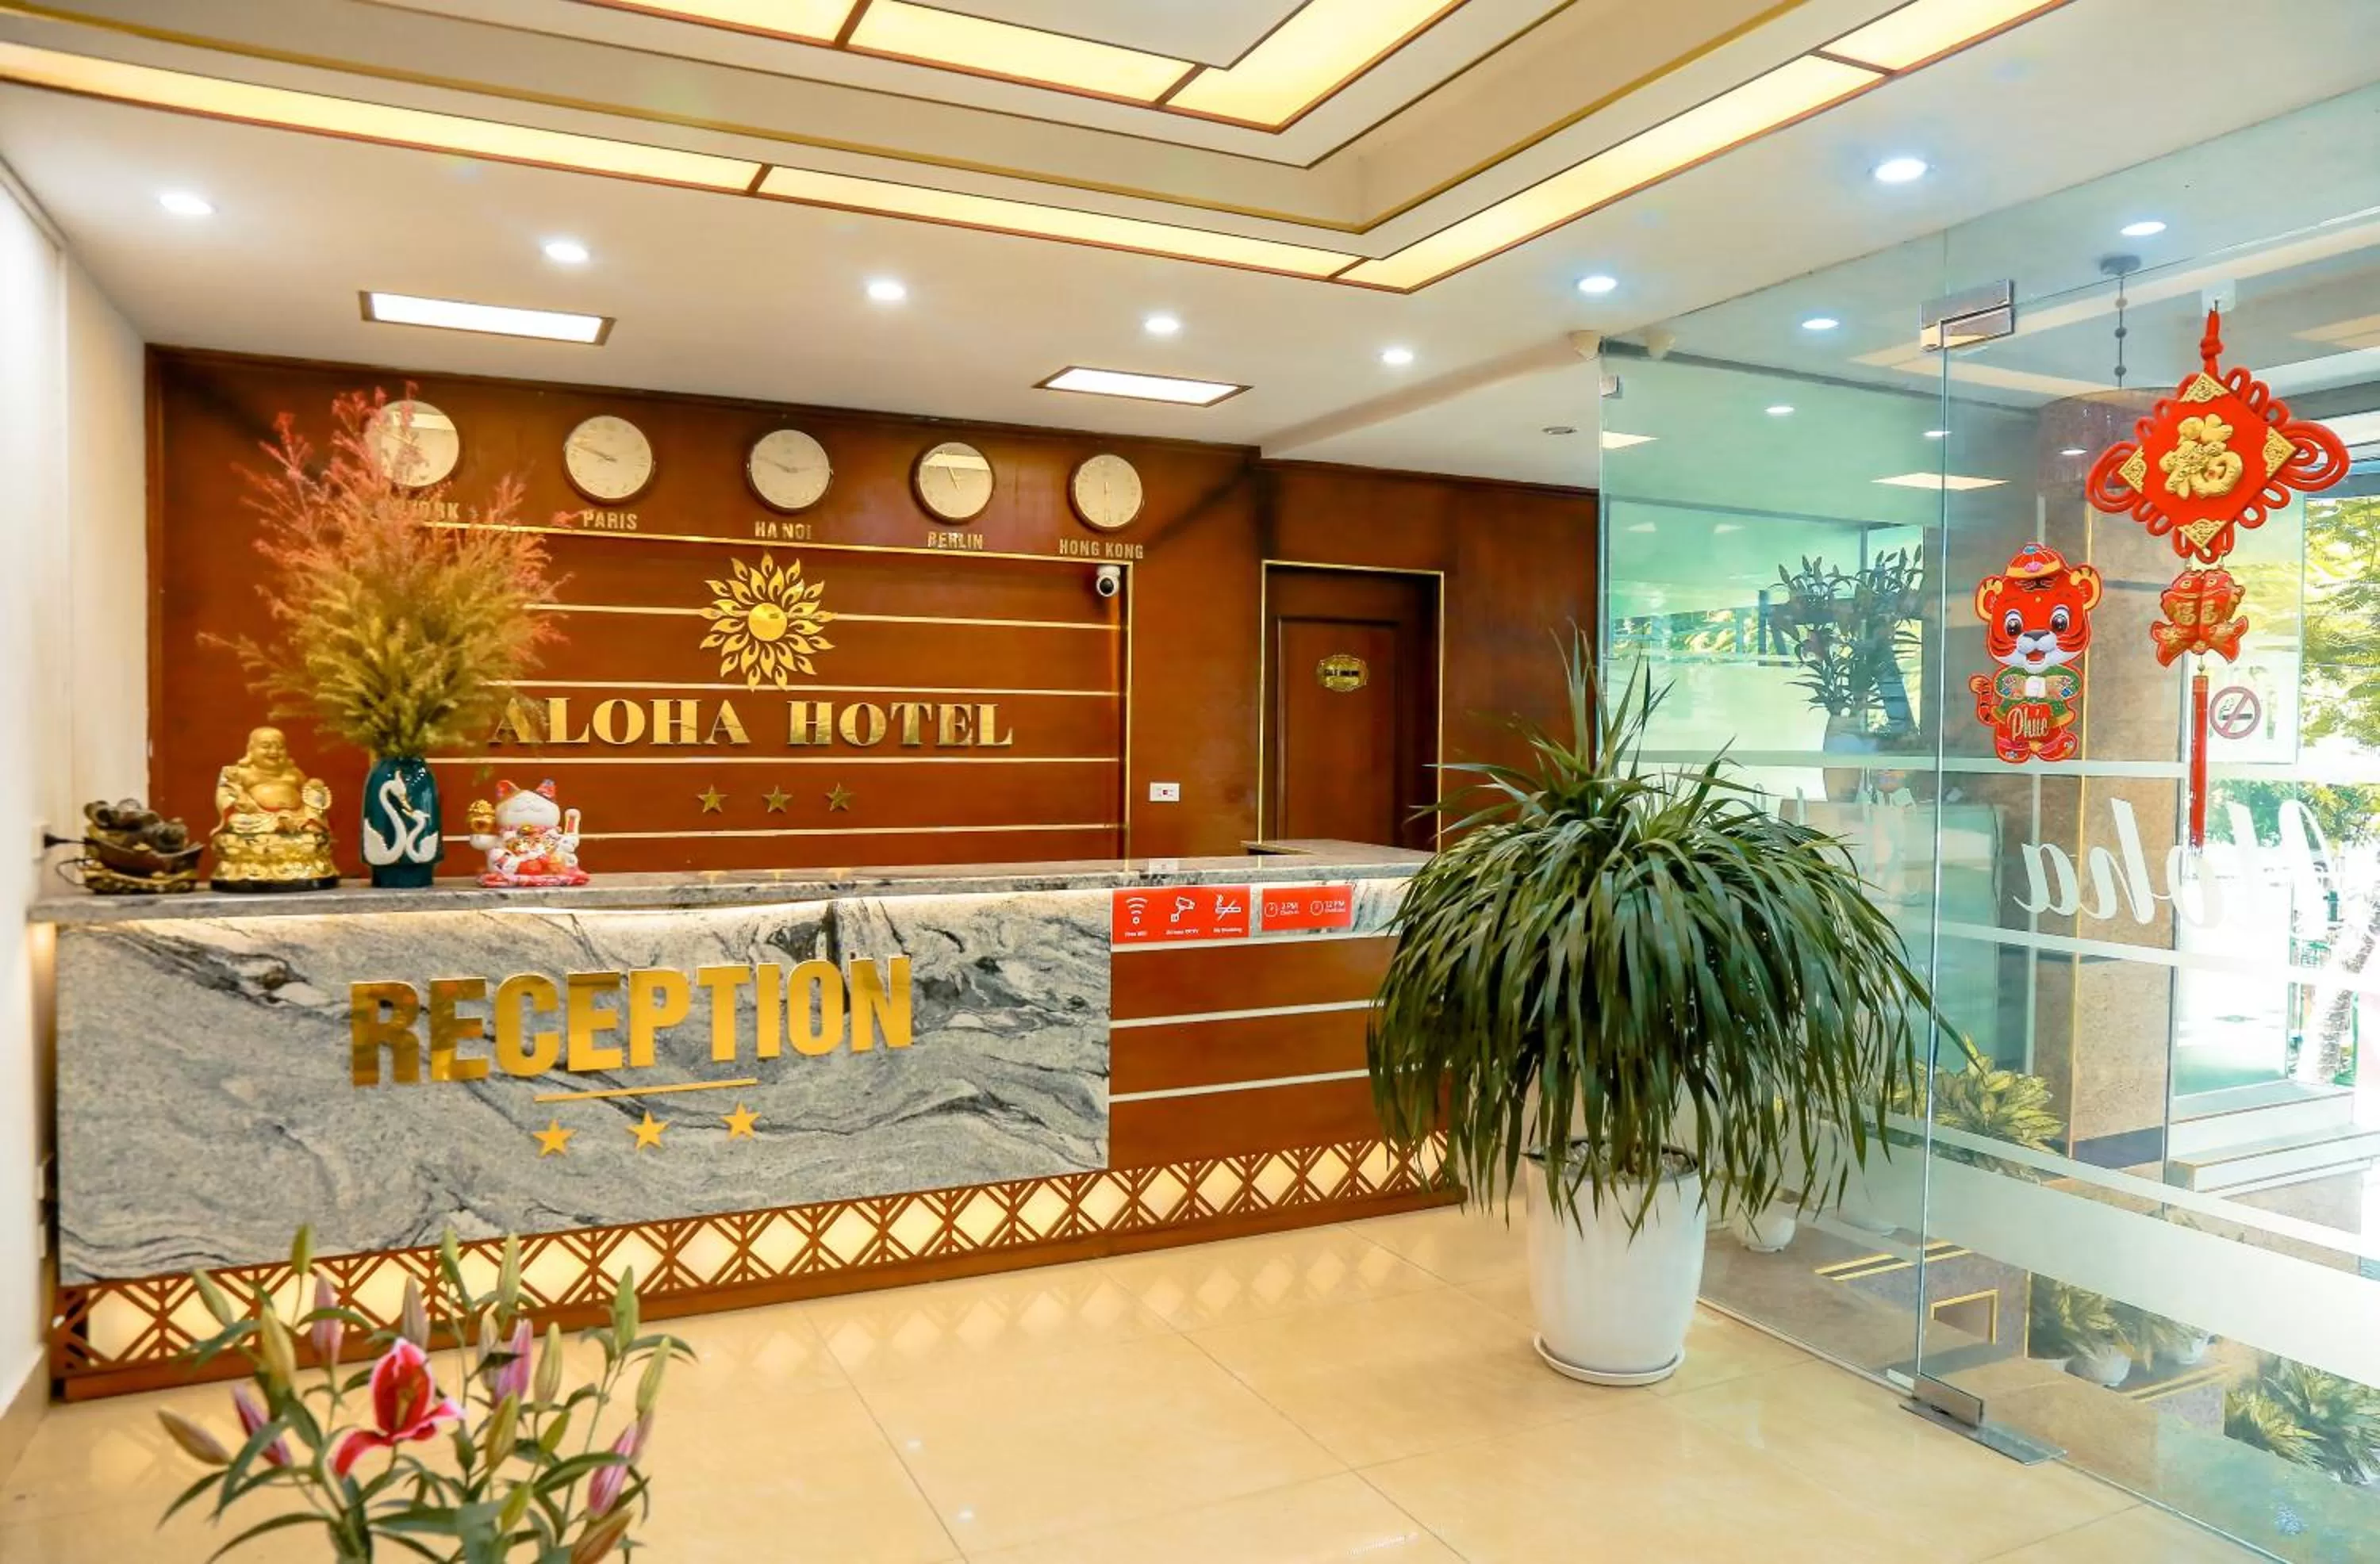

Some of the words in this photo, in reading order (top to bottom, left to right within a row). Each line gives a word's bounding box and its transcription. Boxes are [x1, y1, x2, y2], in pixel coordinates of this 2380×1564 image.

[582, 509, 638, 530] PARIS
[927, 531, 984, 550] BERLIN
[1059, 539, 1100, 556] HONG
[1105, 542, 1144, 559] KONG
[486, 697, 751, 745] ALOHA
[786, 700, 1013, 747] HOTEL
[350, 954, 912, 1089] RECEPTION
